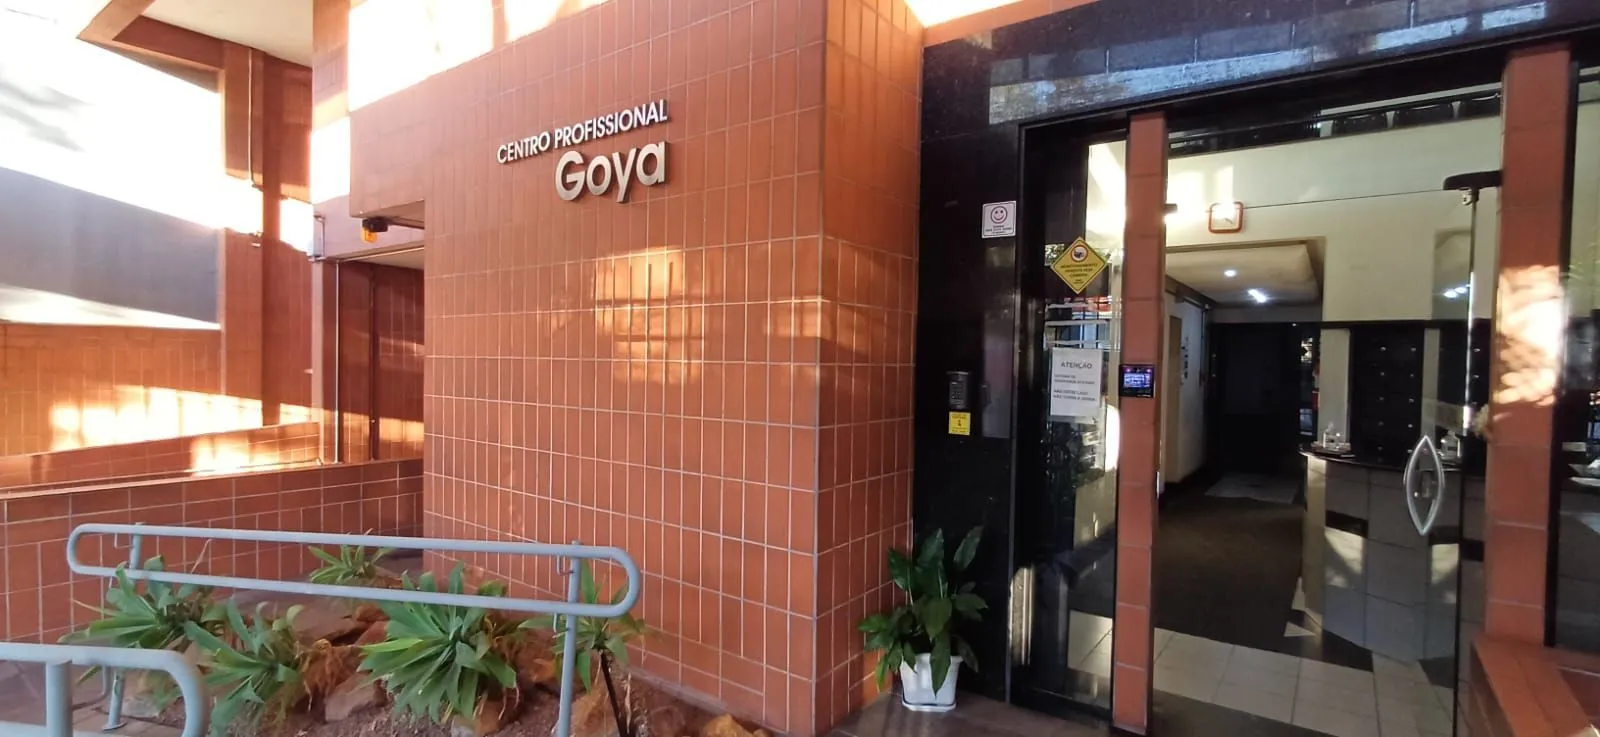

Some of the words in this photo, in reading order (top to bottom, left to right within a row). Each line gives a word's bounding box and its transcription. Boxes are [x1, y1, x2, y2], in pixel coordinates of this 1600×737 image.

[497, 131, 550, 164] CENTRO
[554, 99, 668, 149] PROFISSIONAL
[555, 141, 669, 203] Goya
